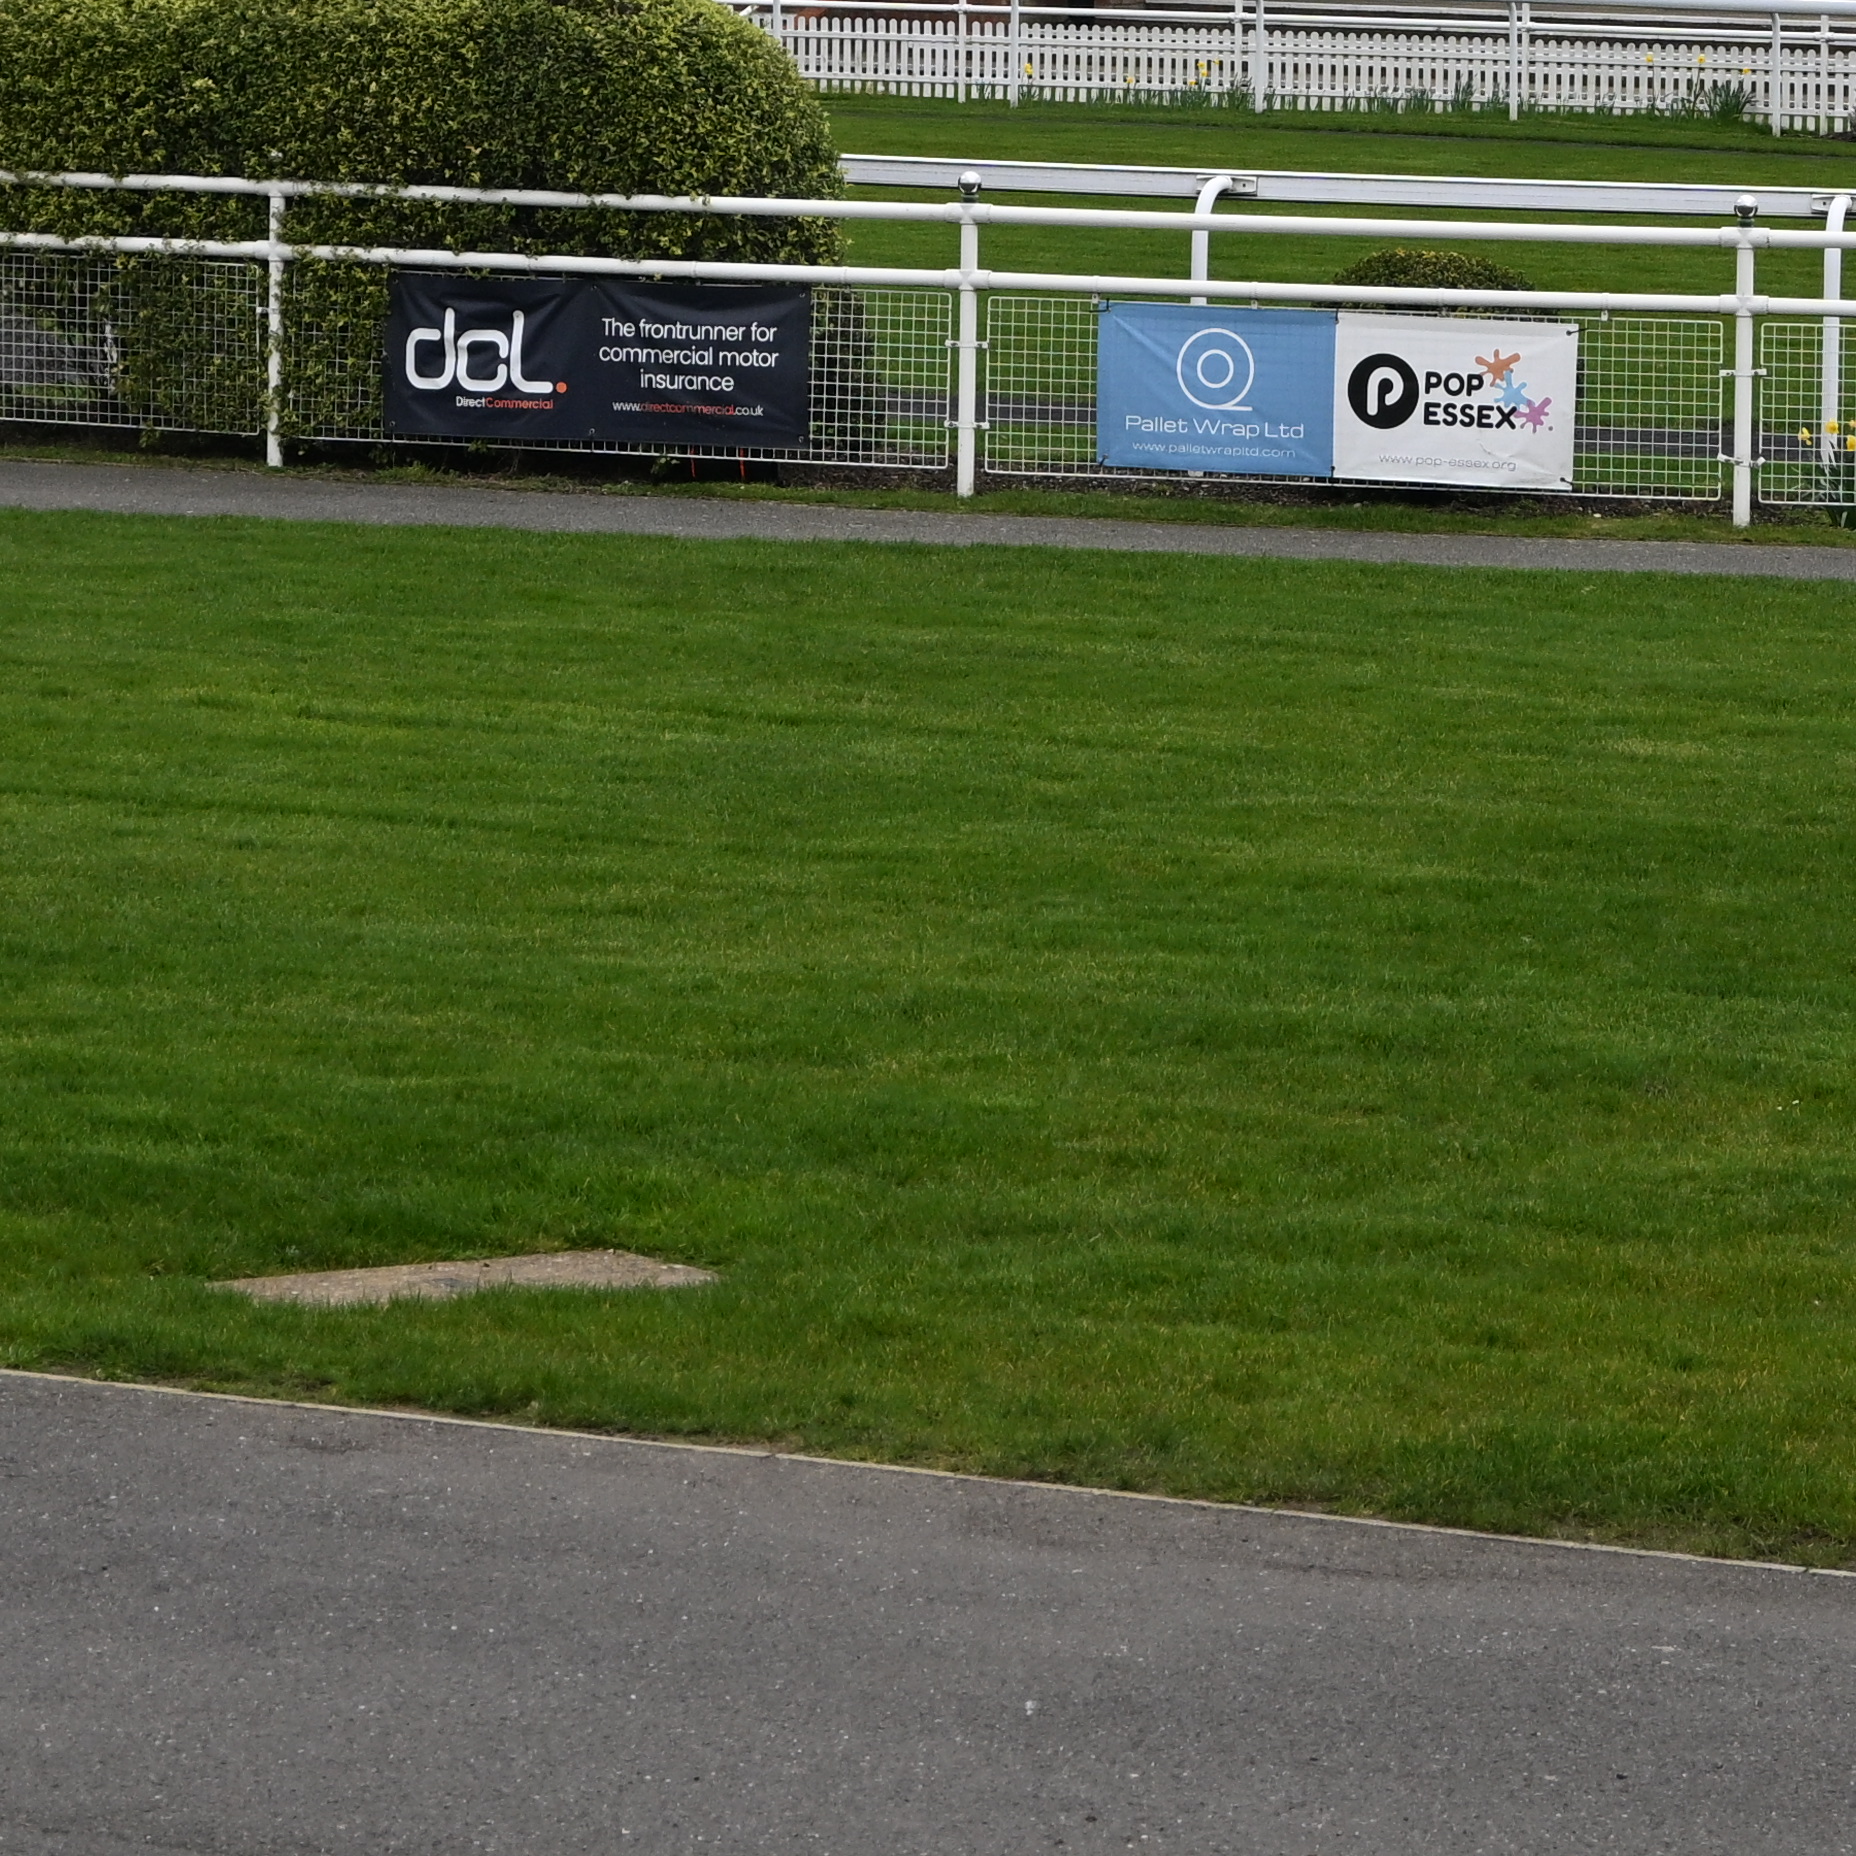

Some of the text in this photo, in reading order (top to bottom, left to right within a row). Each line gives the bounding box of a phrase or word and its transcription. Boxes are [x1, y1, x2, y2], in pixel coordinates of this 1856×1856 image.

[601, 317, 778, 342] The frontrunner for
[599, 345, 780, 368] commercial motor
[640, 368, 735, 392] insurance
[1424, 371, 1485, 397] POP
[455, 395, 554, 410] DirectCommercial
[612, 401, 764, 416] www.directcommercial.co.uk
[1423, 401, 1518, 430] ESSEX
[1125, 415, 1304, 440] Pallet Wrap Ltd
[1132, 442, 1296, 458] www.palletwrapltd.com
[1379, 454, 1517, 472] www.pop-essex.org
